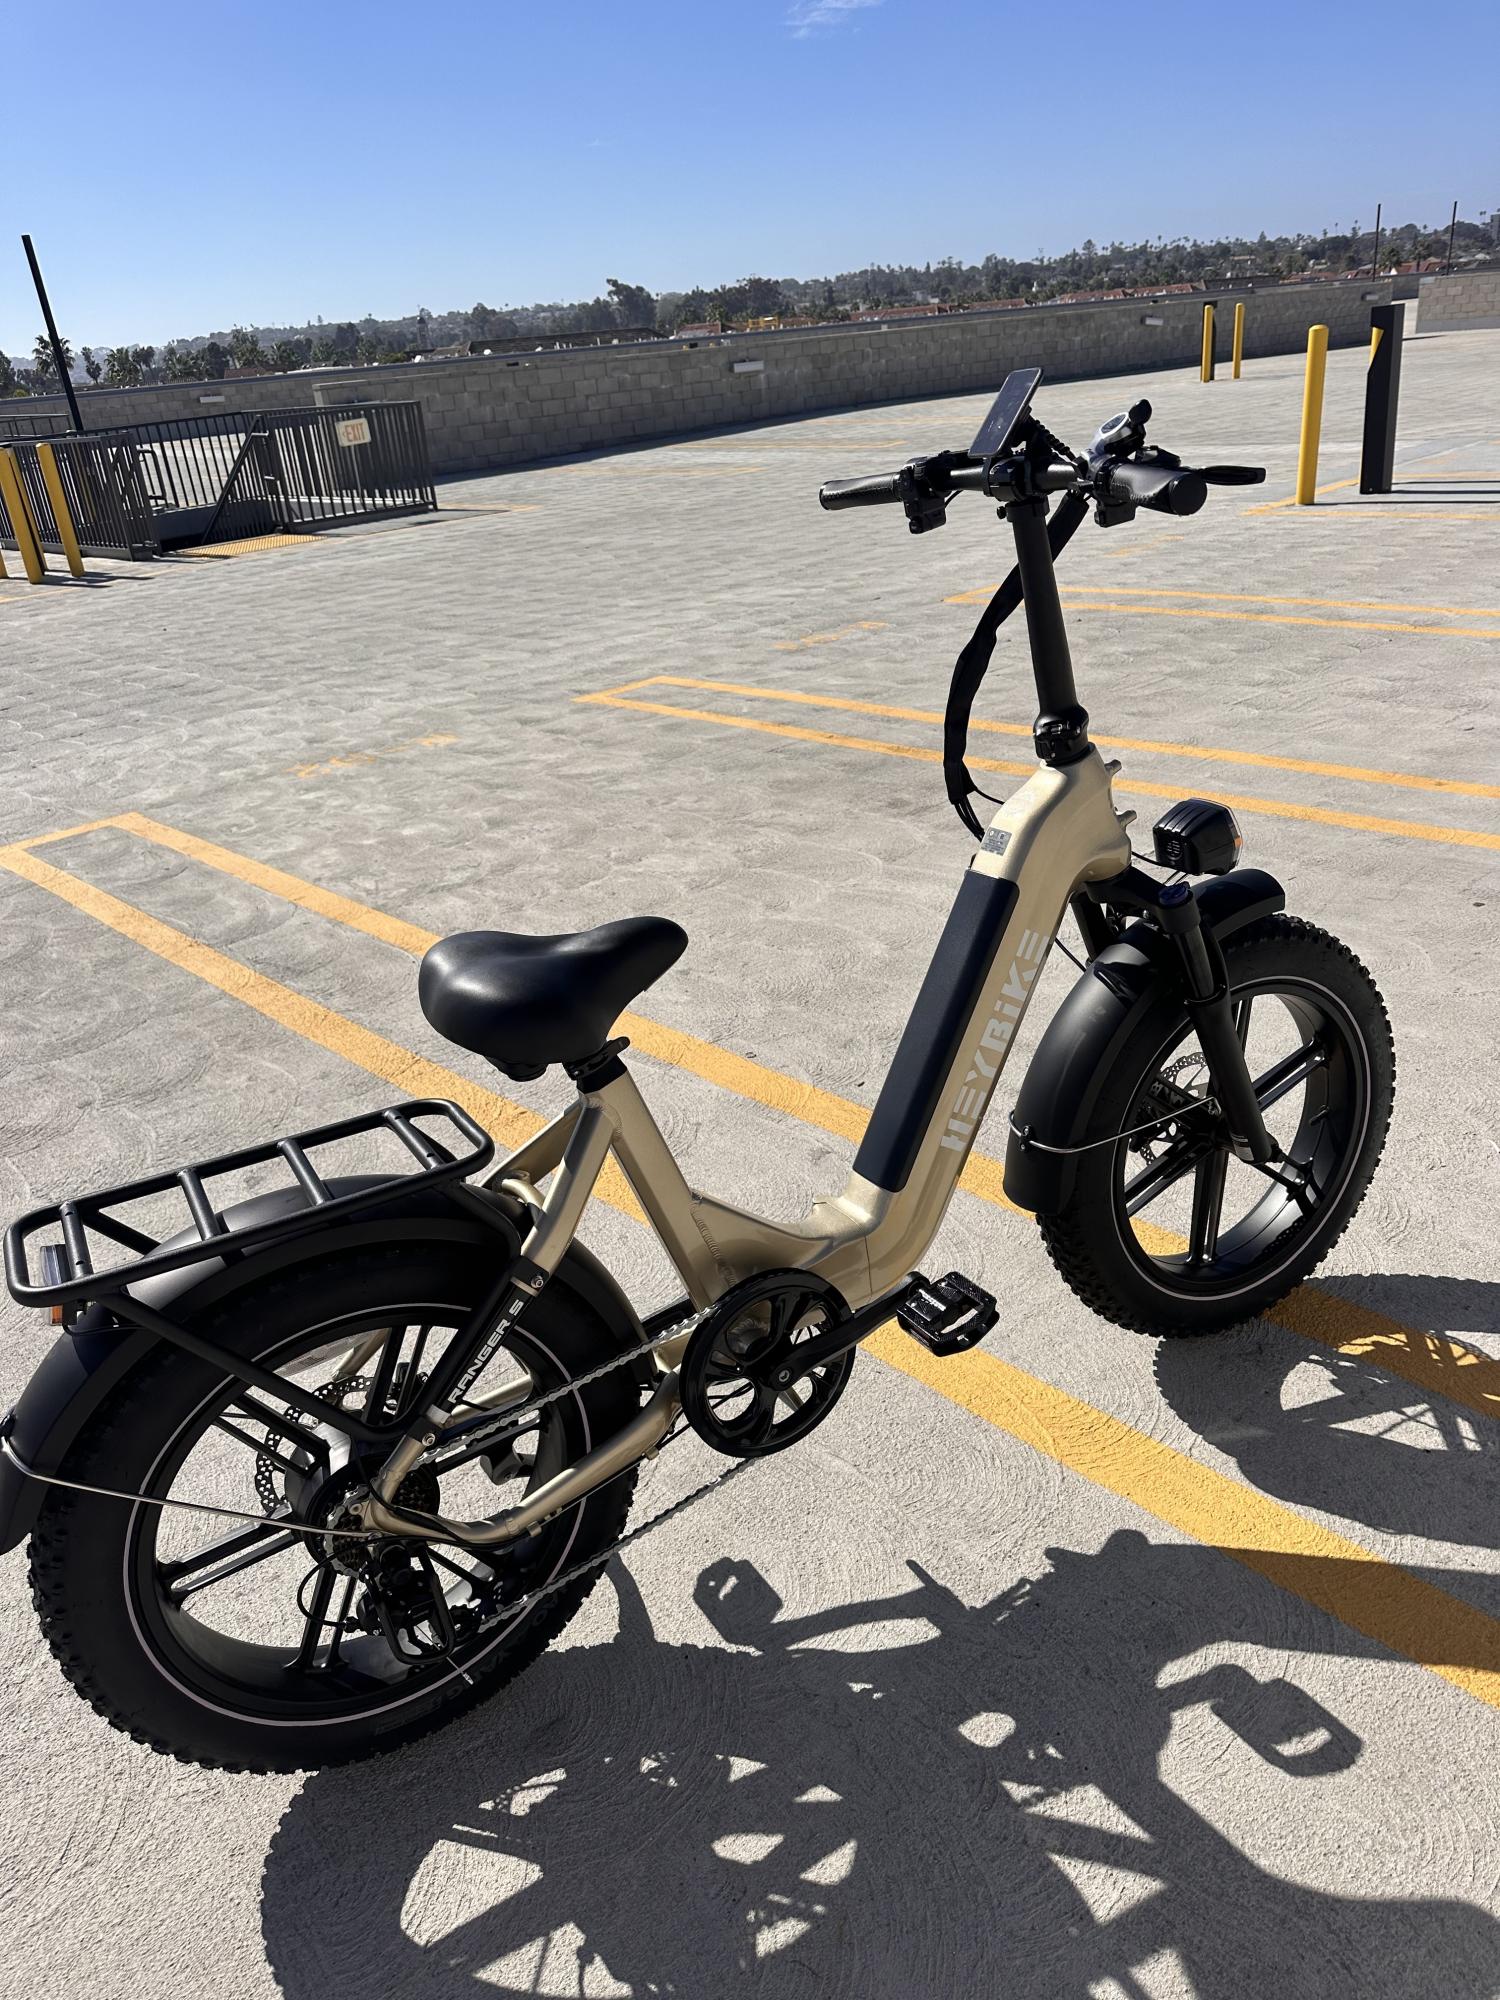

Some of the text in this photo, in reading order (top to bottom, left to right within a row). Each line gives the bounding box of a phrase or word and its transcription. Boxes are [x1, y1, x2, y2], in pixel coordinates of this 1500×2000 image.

[344, 423, 366, 442] EXIT
[448, 1299, 525, 1404] RANGER S
